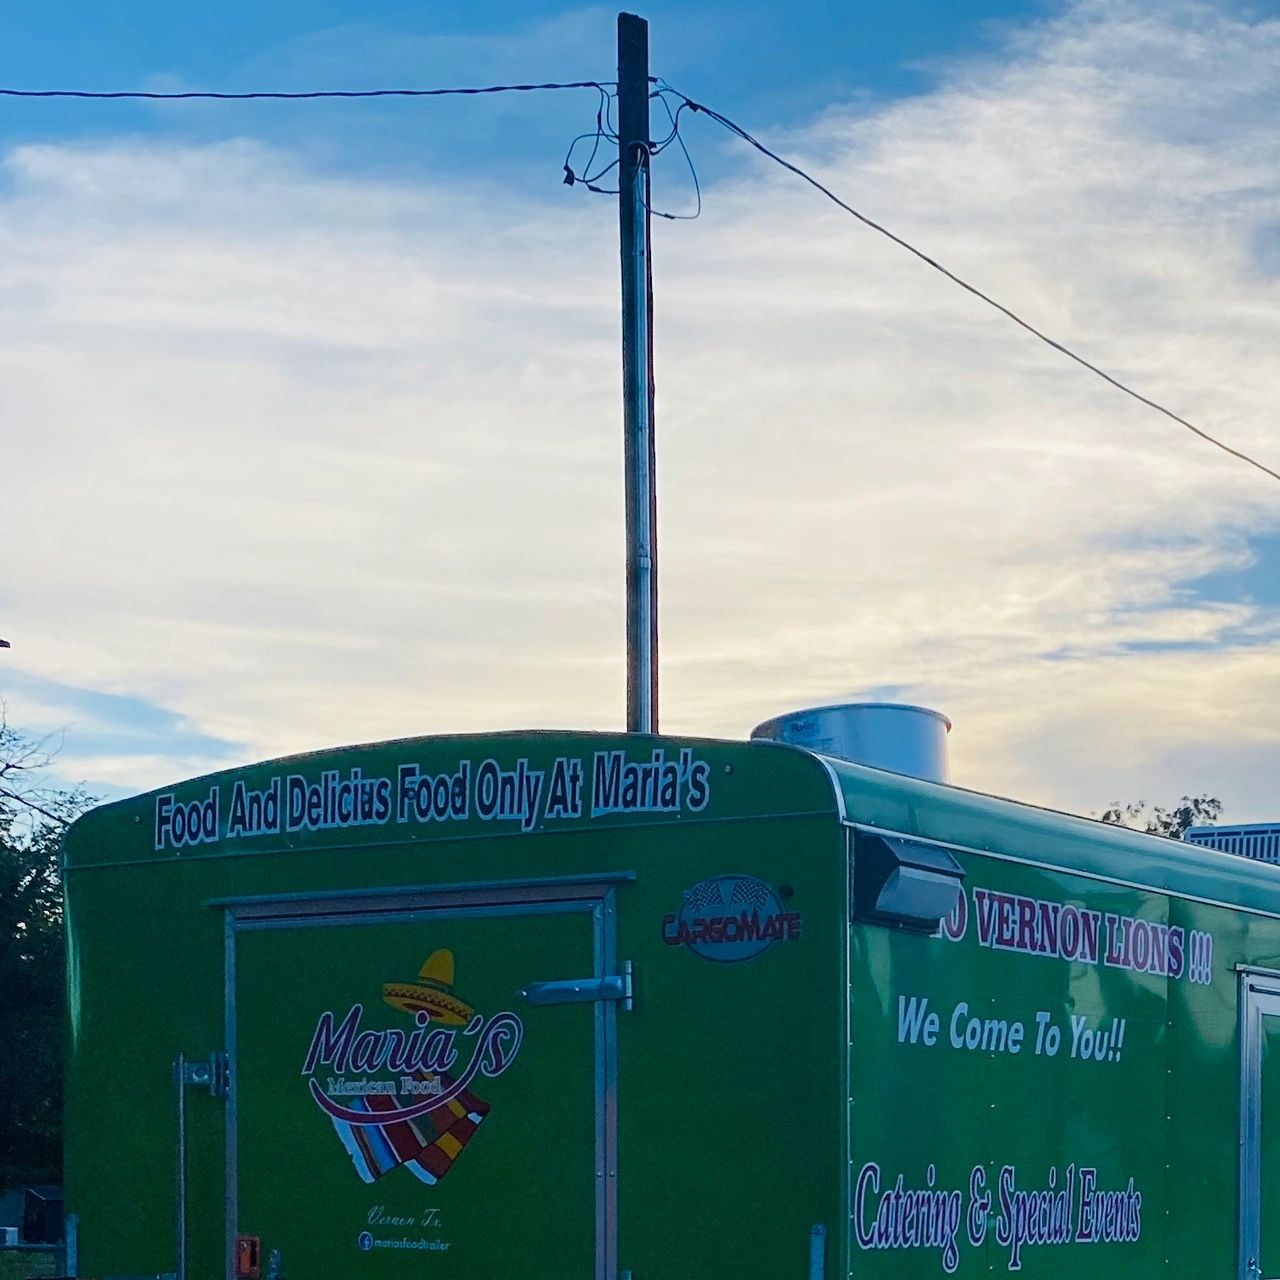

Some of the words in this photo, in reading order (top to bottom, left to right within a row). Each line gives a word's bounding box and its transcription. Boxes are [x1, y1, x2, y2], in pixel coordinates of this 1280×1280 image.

[155, 786, 219, 850] Food
[226, 777, 281, 838] And
[397, 763, 470, 823] Food
[475, 758, 545, 831] Only
[544, 757, 583, 818] At
[591, 748, 710, 818] Maria's
[973, 887, 1101, 965] VERNON
[1104, 913, 1184, 979] LIONS
[897, 995, 940, 1047] We
[950, 1002, 1024, 1055] Come
[1034, 1012, 1061, 1056] To
[1070, 1015, 1126, 1063] You!!
[326, 1076, 396, 1096] Mexican
[400, 1076, 443, 1096] Food
[855, 1161, 961, 1273] Catering
[968, 1165, 991, 1246] &
[996, 1163, 1074, 1270] Special
[1075, 1167, 1141, 1242] Events
